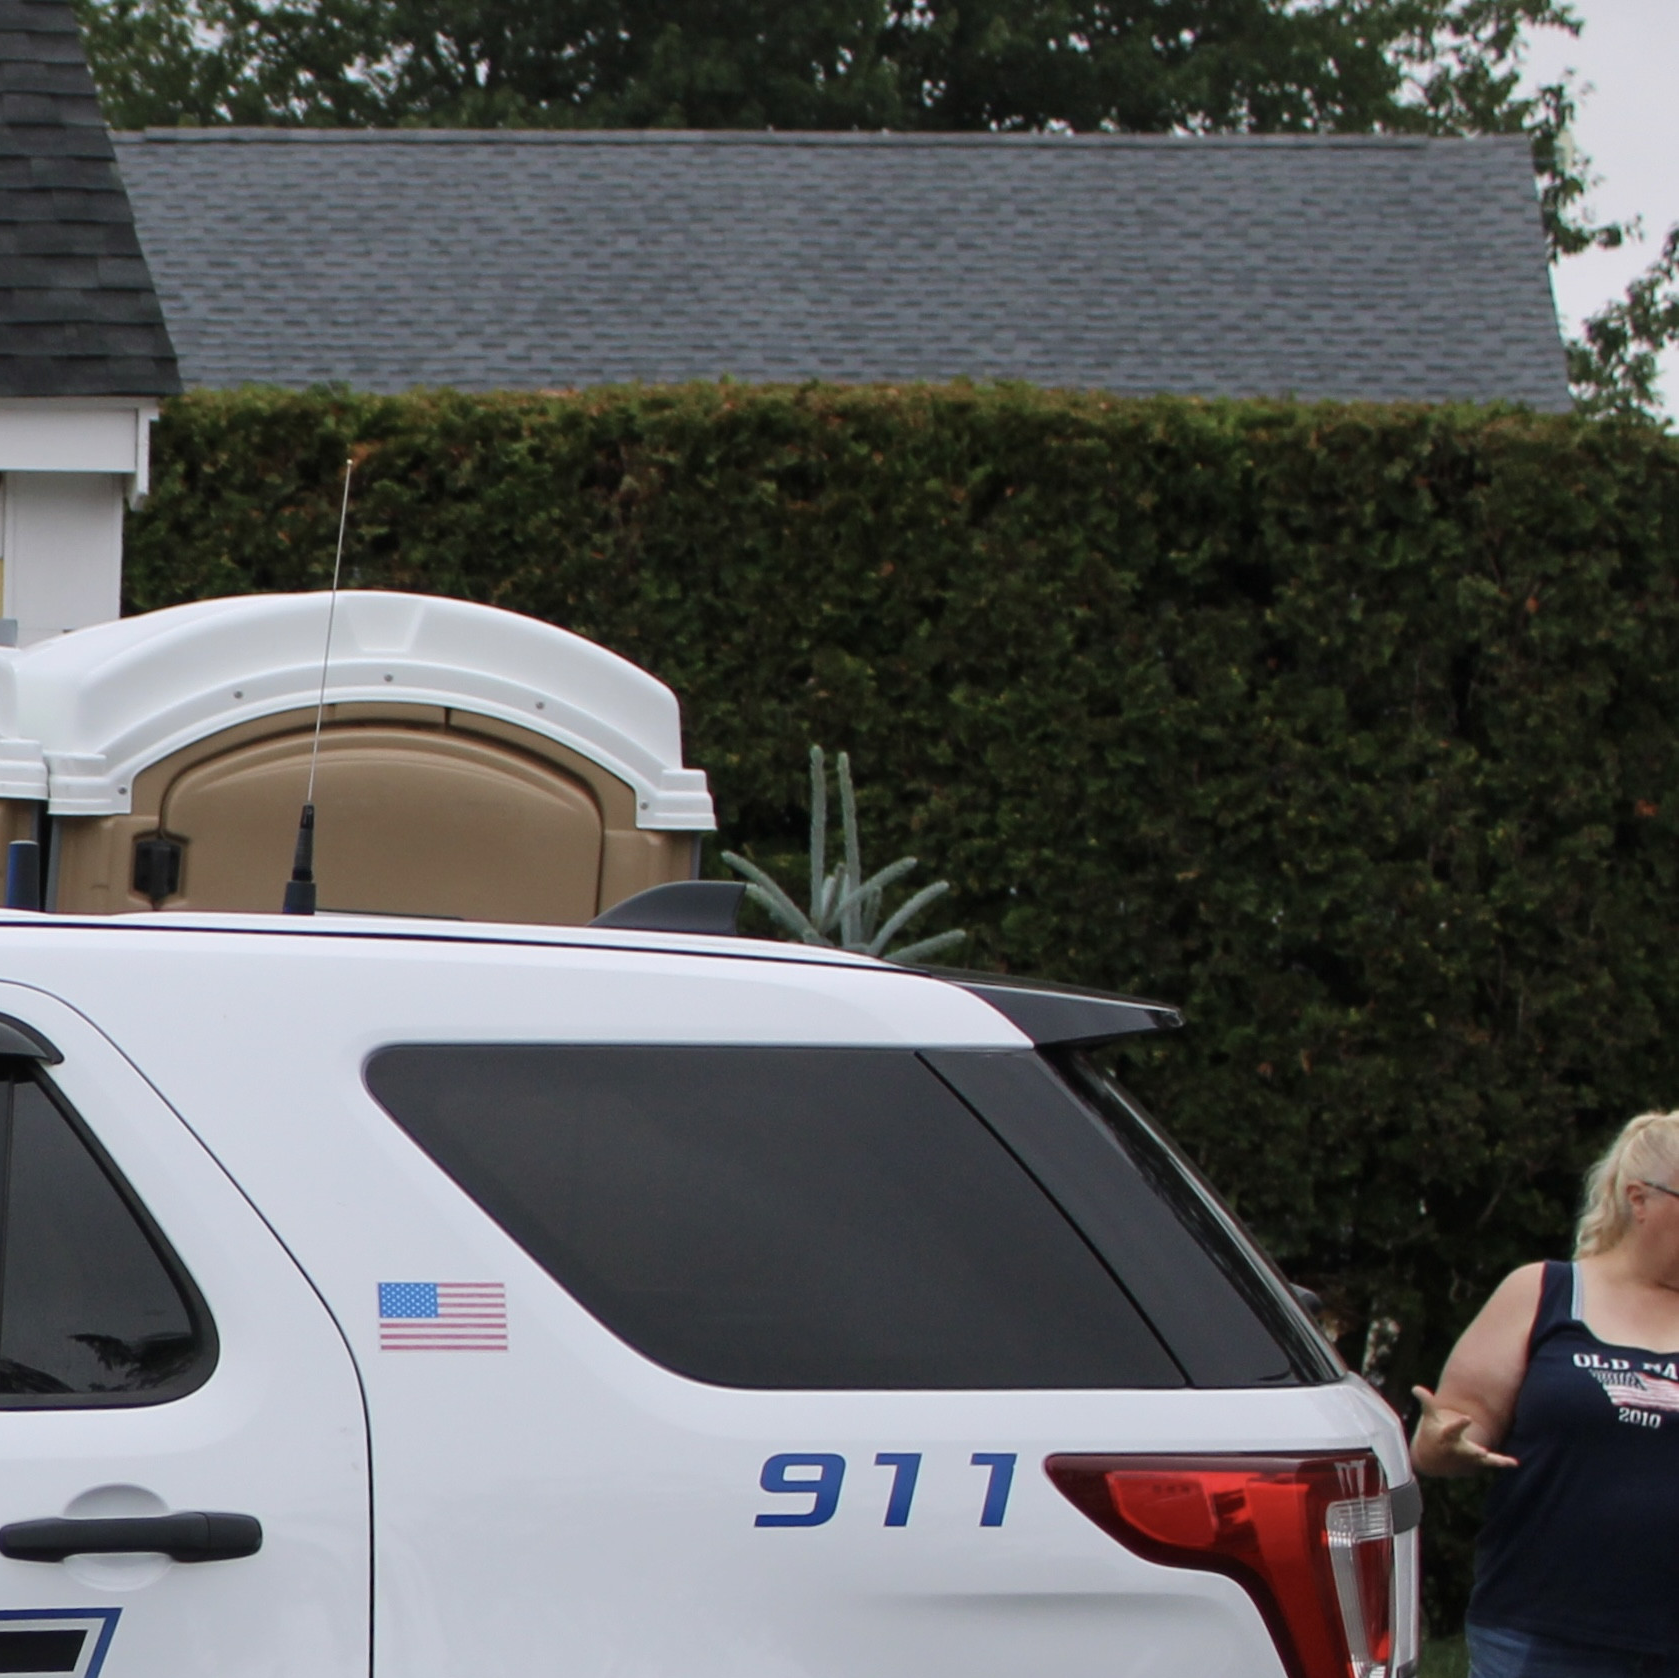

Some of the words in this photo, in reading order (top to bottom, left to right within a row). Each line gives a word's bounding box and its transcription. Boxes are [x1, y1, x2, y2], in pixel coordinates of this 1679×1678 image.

[1573, 1353, 1630, 1370] OLD
[1619, 1406, 1661, 1429] 2010
[754, 1452, 1018, 1527] 911
